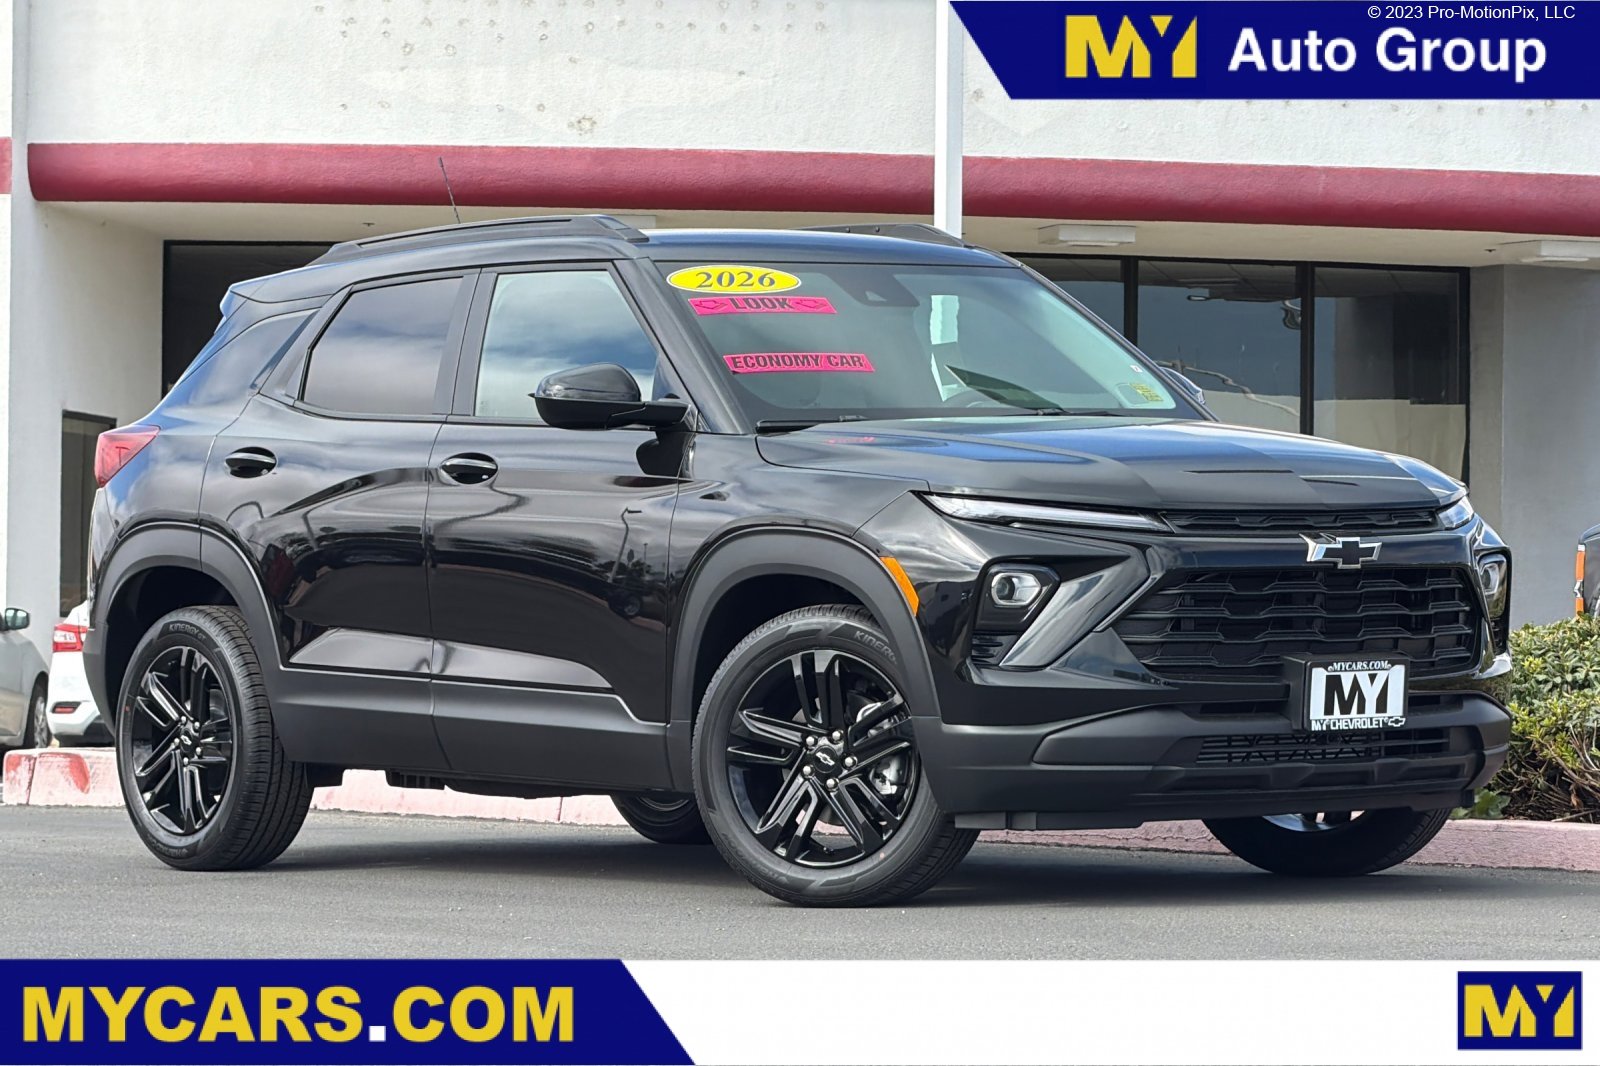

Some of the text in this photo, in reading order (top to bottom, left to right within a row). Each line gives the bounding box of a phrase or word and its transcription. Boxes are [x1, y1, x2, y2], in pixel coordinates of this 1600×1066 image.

[695, 271, 776, 288] 2026
[728, 297, 794, 310] LOOK
[732, 354, 864, 369] ECONOMY CAR
[853, 630, 898, 665] KINERG
[1332, 660, 1389, 671] MYCARS.COM
[1323, 673, 1389, 716] MY
[1330, 718, 1384, 730] CHEVROLET
